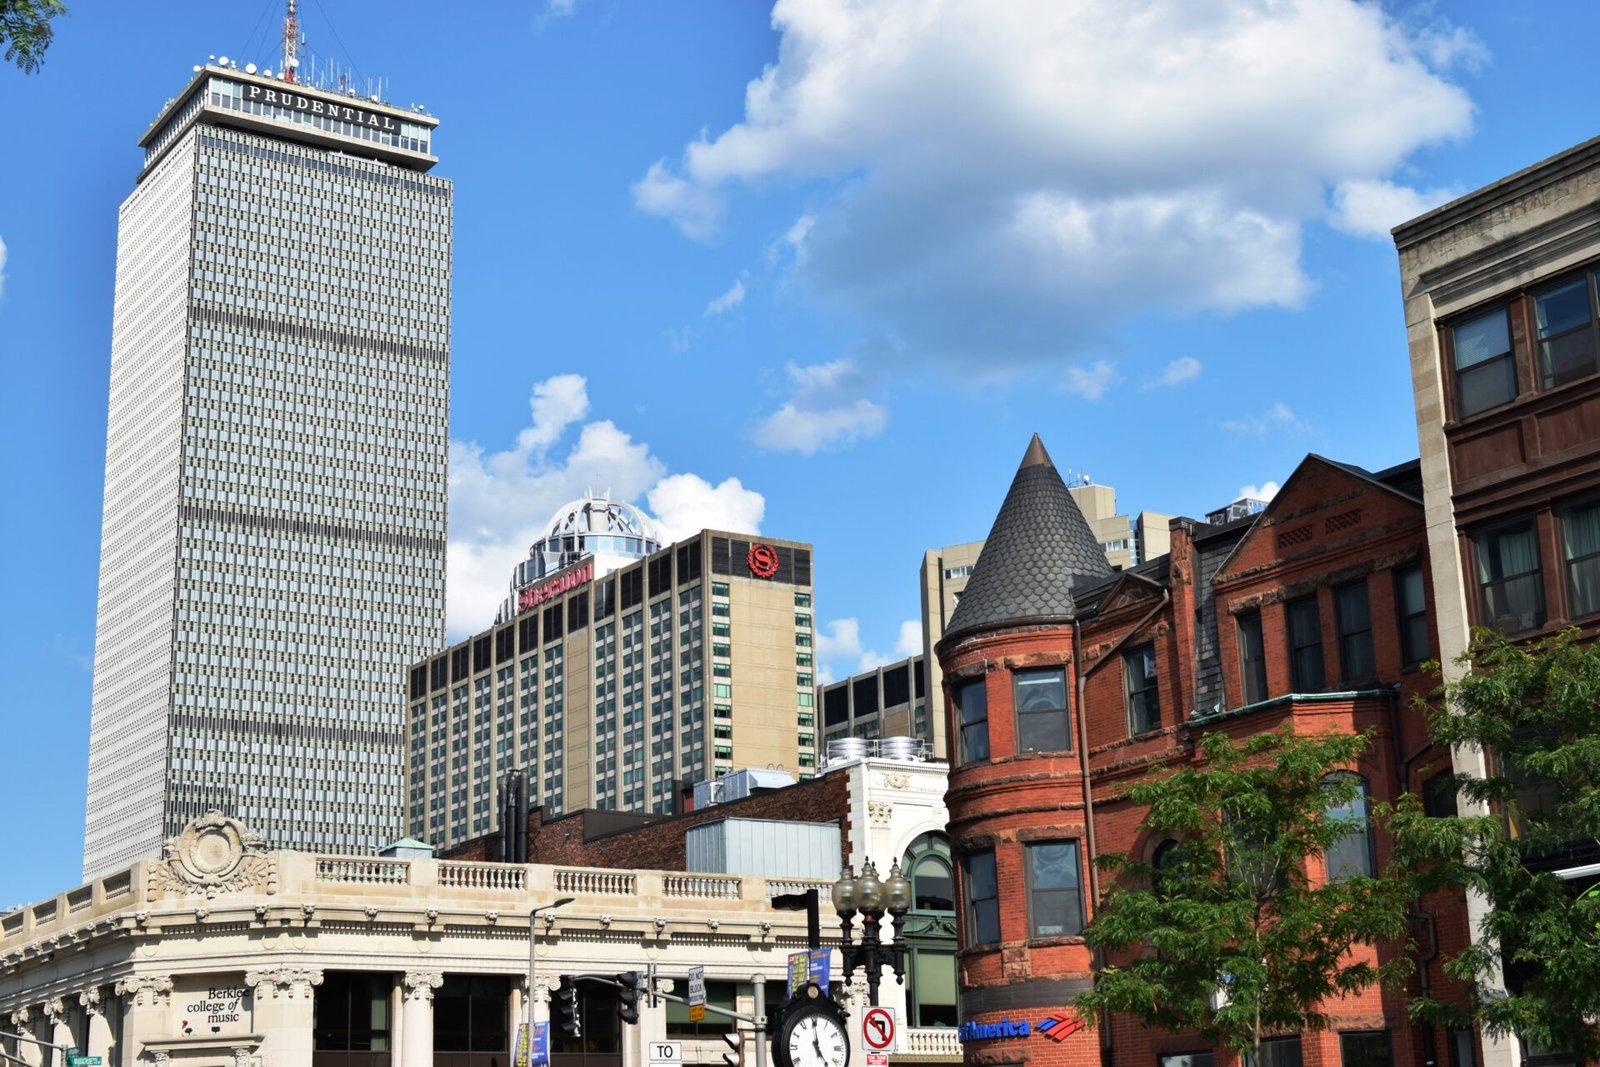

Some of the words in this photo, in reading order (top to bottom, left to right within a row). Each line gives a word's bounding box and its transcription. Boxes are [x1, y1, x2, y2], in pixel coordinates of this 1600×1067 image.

[249, 85, 395, 130] PRUDENTIAL
[754, 548, 772, 569] S
[517, 562, 593, 612] Sheraton
[208, 986, 250, 1000] Berklee
[690, 983, 702, 994] BLOCK
[187, 1000, 225, 1014] college
[227, 997, 241, 1013] of
[207, 1013, 240, 1023] music
[970, 1017, 1030, 1040] America
[656, 1045, 674, 1058] TO
